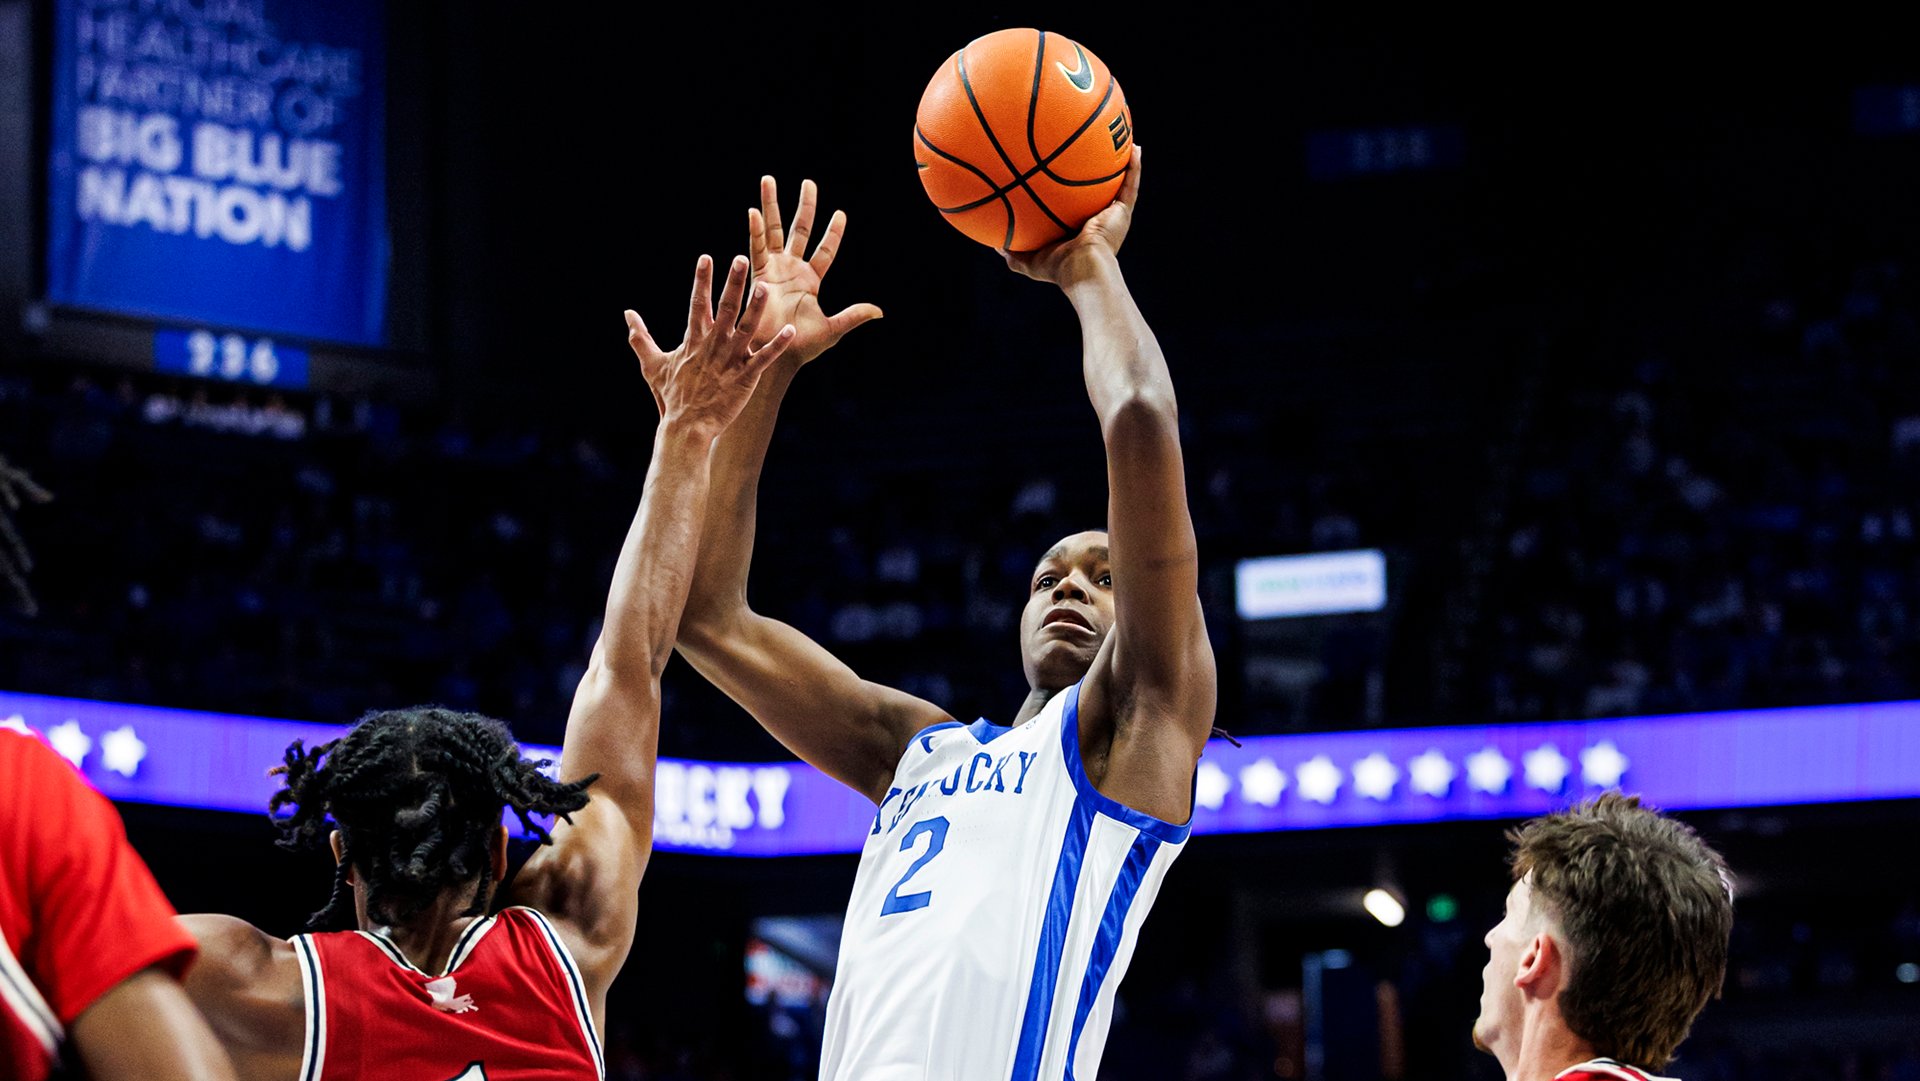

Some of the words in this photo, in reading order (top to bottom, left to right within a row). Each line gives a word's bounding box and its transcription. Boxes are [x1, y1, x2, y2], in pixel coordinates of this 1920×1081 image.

[78, 106, 182, 171] BIG
[193, 122, 342, 195] BLUE
[77, 168, 312, 252] NATION
[880, 815, 950, 917] 2
